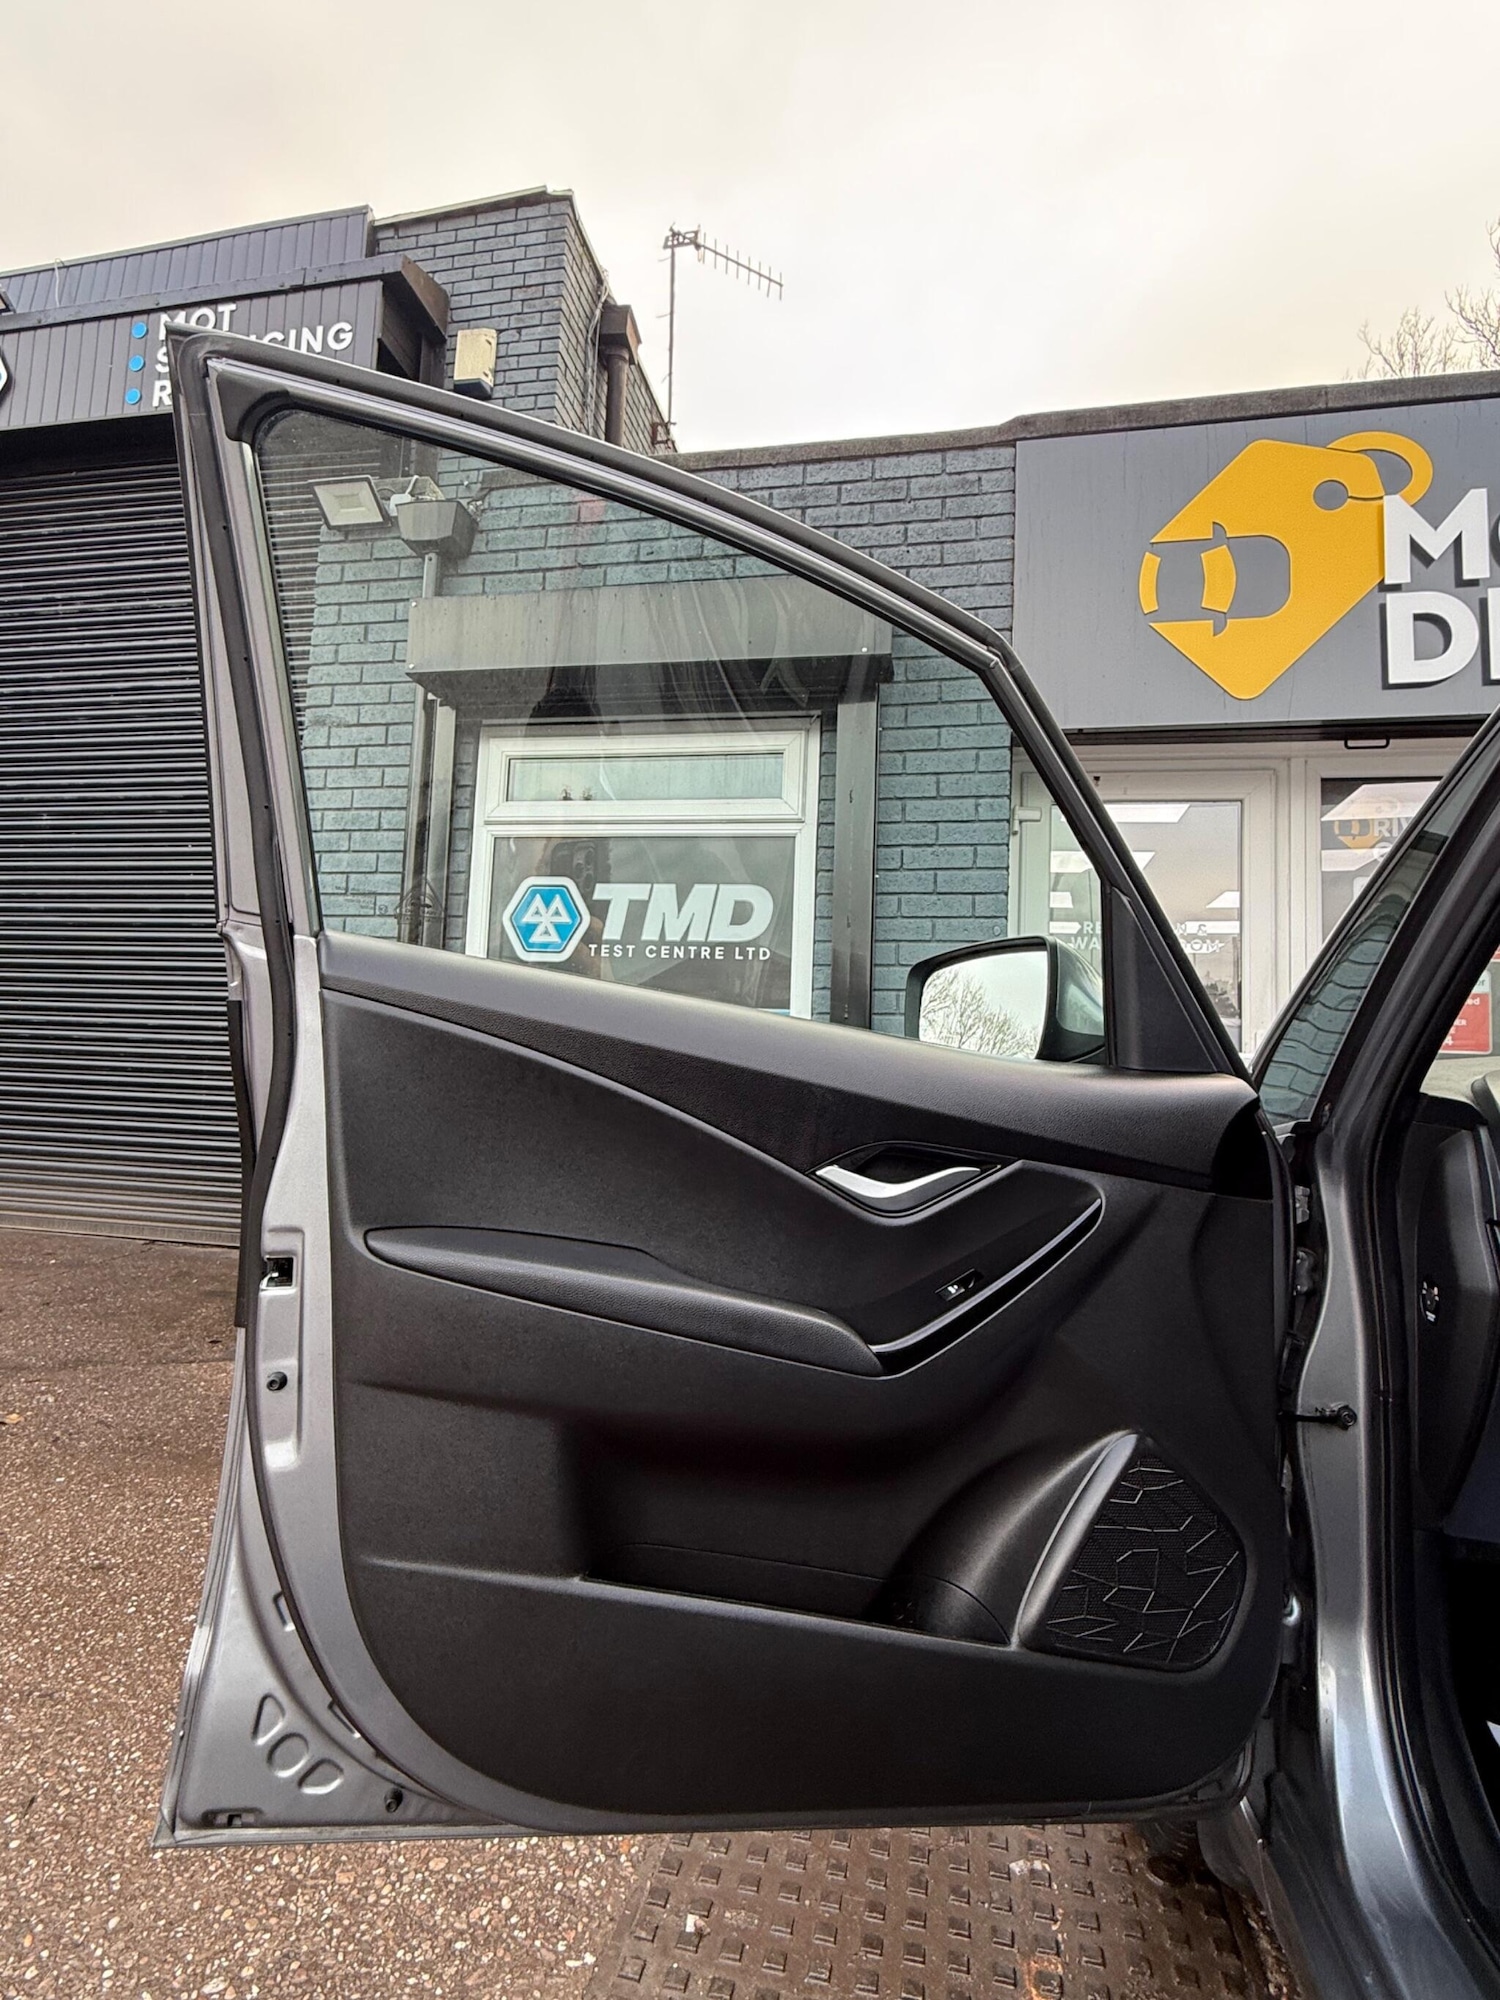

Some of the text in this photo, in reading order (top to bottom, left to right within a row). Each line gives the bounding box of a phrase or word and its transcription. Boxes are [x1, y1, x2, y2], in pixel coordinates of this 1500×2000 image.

[592, 883, 774, 942] TMD
[588, 944, 771, 961] TEST CENTRE LTD
